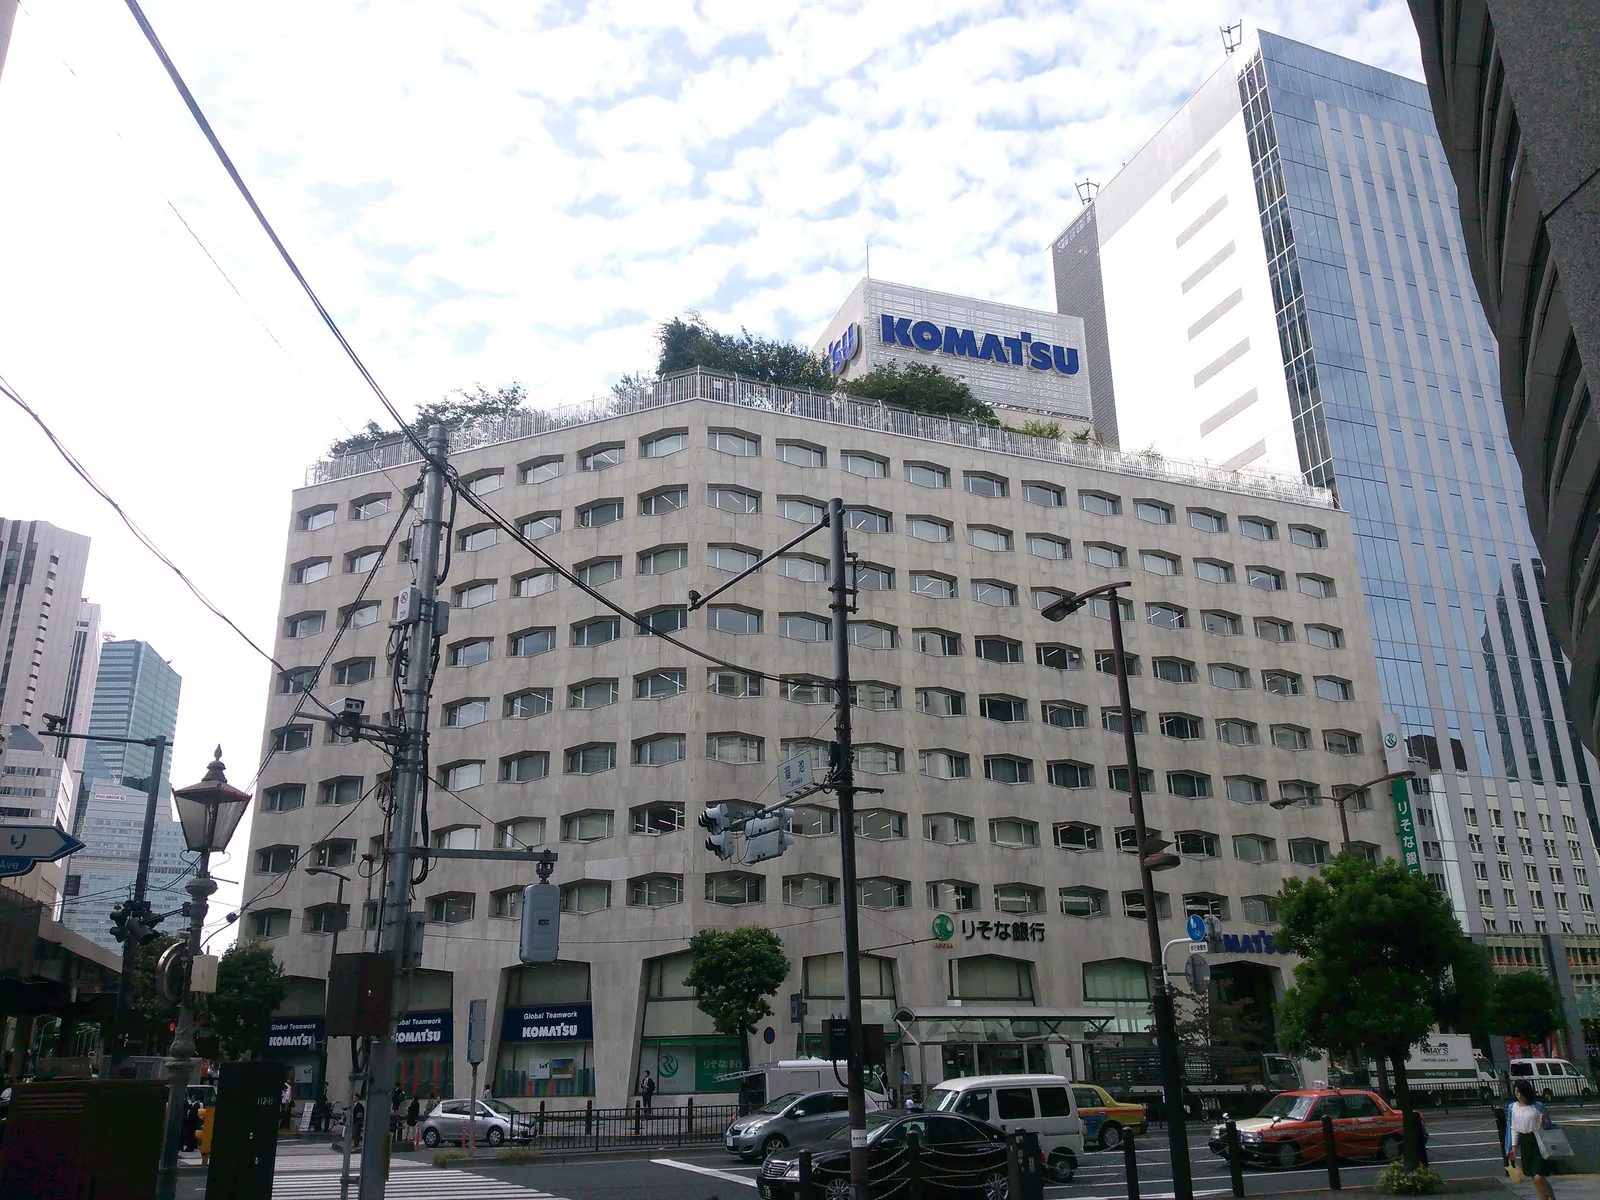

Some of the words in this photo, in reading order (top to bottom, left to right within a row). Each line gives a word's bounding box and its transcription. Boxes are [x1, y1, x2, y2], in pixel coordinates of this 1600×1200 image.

[880, 314, 1079, 375] KOMATSU
[961, 920, 1046, 942] りそな銀行
[412, 1017, 442, 1025] Teamwork
[523, 1012, 544, 1020] Global
[546, 1011, 578, 1019] Teamwork
[522, 1022, 578, 1038] KOMATSU
